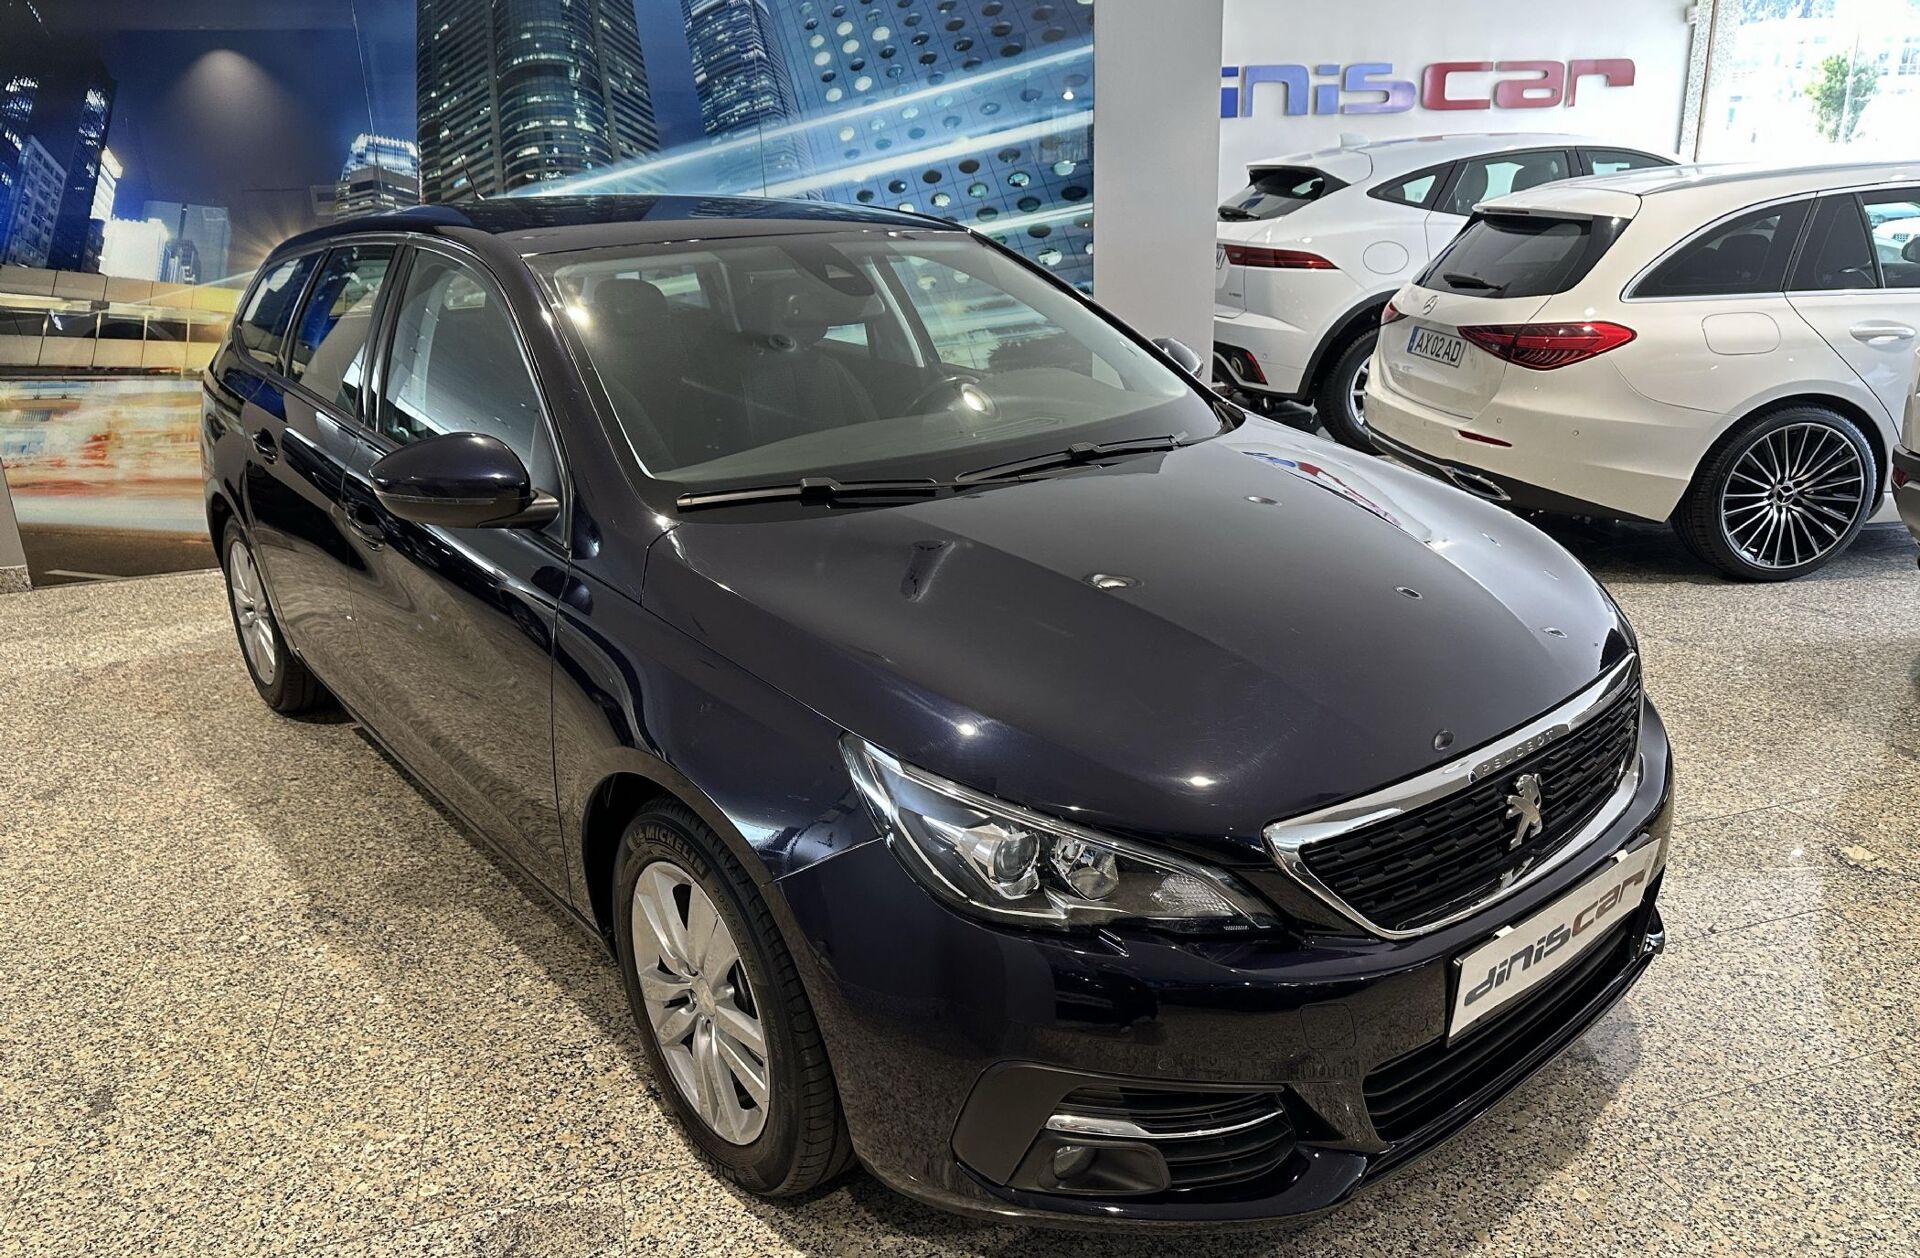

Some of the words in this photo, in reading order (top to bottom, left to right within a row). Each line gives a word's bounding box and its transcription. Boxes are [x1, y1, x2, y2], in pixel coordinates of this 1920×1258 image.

[1221, 58, 1635, 118] iniscar
[1482, 729, 1553, 775] PEUGEOT
[645, 825, 706, 874] MICHELIN
[1463, 869, 1646, 1007] diniscar
